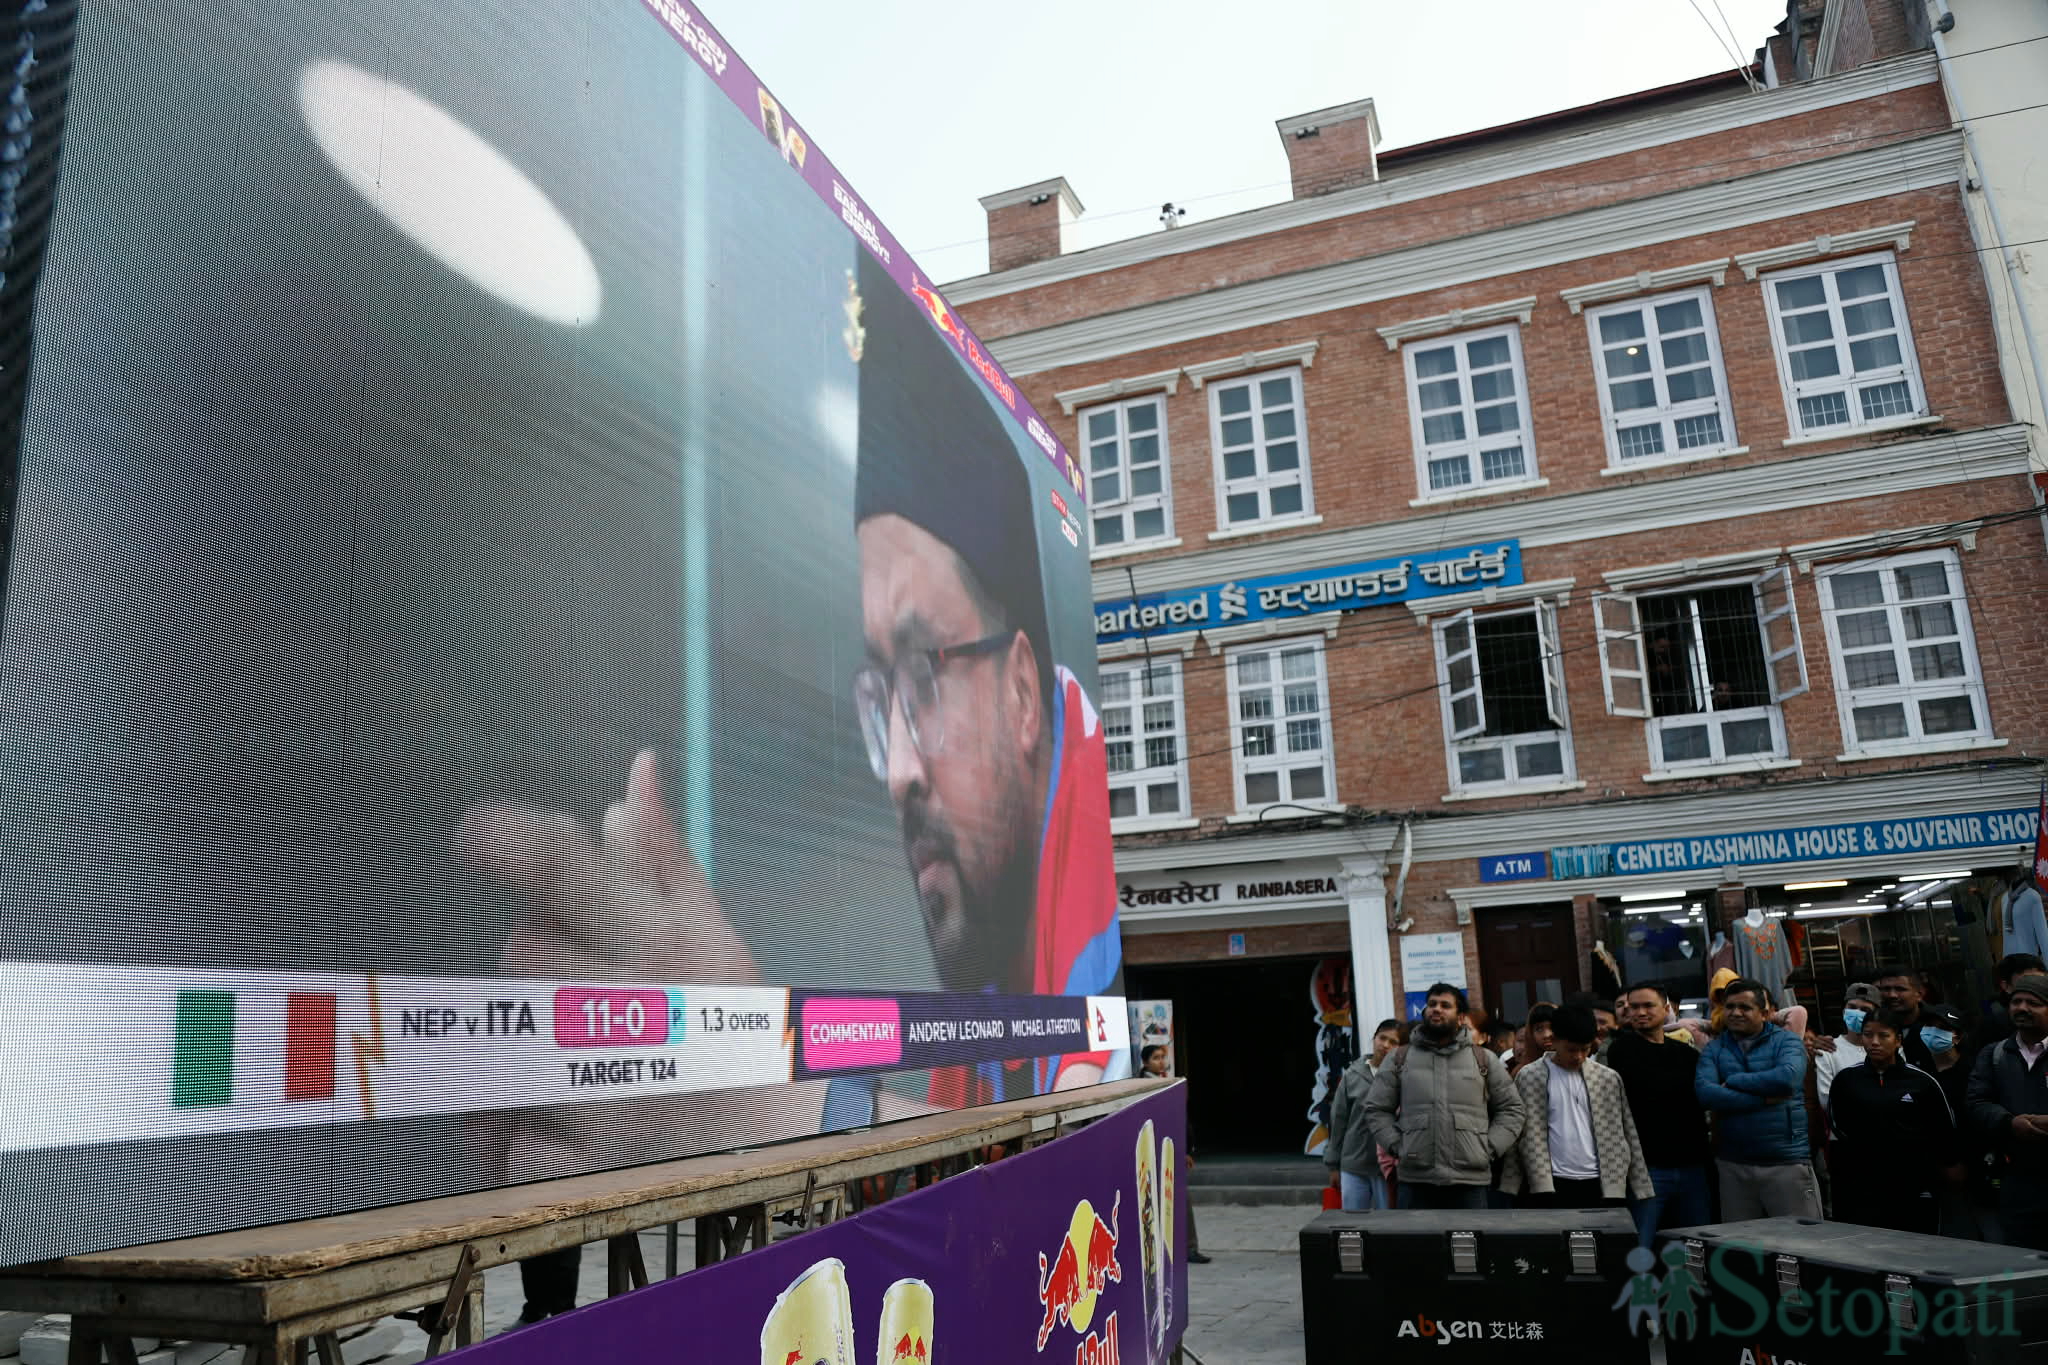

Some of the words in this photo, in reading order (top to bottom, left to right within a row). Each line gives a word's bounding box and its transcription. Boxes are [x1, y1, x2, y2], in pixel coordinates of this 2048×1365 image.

[1417, 546, 1511, 586] चार्टर्ड
[1095, 592, 1209, 634] artered
[1617, 845, 1688, 871] CENTER
[1691, 832, 1791, 864] PASHMINA
[1794, 827, 1859, 858] HOUSE
[1863, 825, 1879, 851] &
[1882, 816, 1985, 850] SOUVENIR
[1495, 859, 1532, 875] ATM
[1237, 877, 1337, 900] RAINBASERA
[402, 1008, 457, 1036] NEP
[487, 1000, 536, 1036] ITA
[582, 1000, 645, 1037] 11-0
[701, 1007, 724, 1032] 1.3
[729, 1013, 770, 1030] OVERS
[1011, 1020, 1045, 1037] MICHAEL
[1046, 1018, 1081, 1035] ATHERTON
[810, 1023, 896, 1044] COMMENTARY
[908, 1021, 957, 1043] ANDREW
[959, 1020, 1004, 1040] LEONARD
[567, 1061, 643, 1086] TARGET
[650, 1058, 677, 1081] 124
[1397, 1313, 1483, 1345] Absen
[1488, 1321, 1544, 1341] 艾比森
